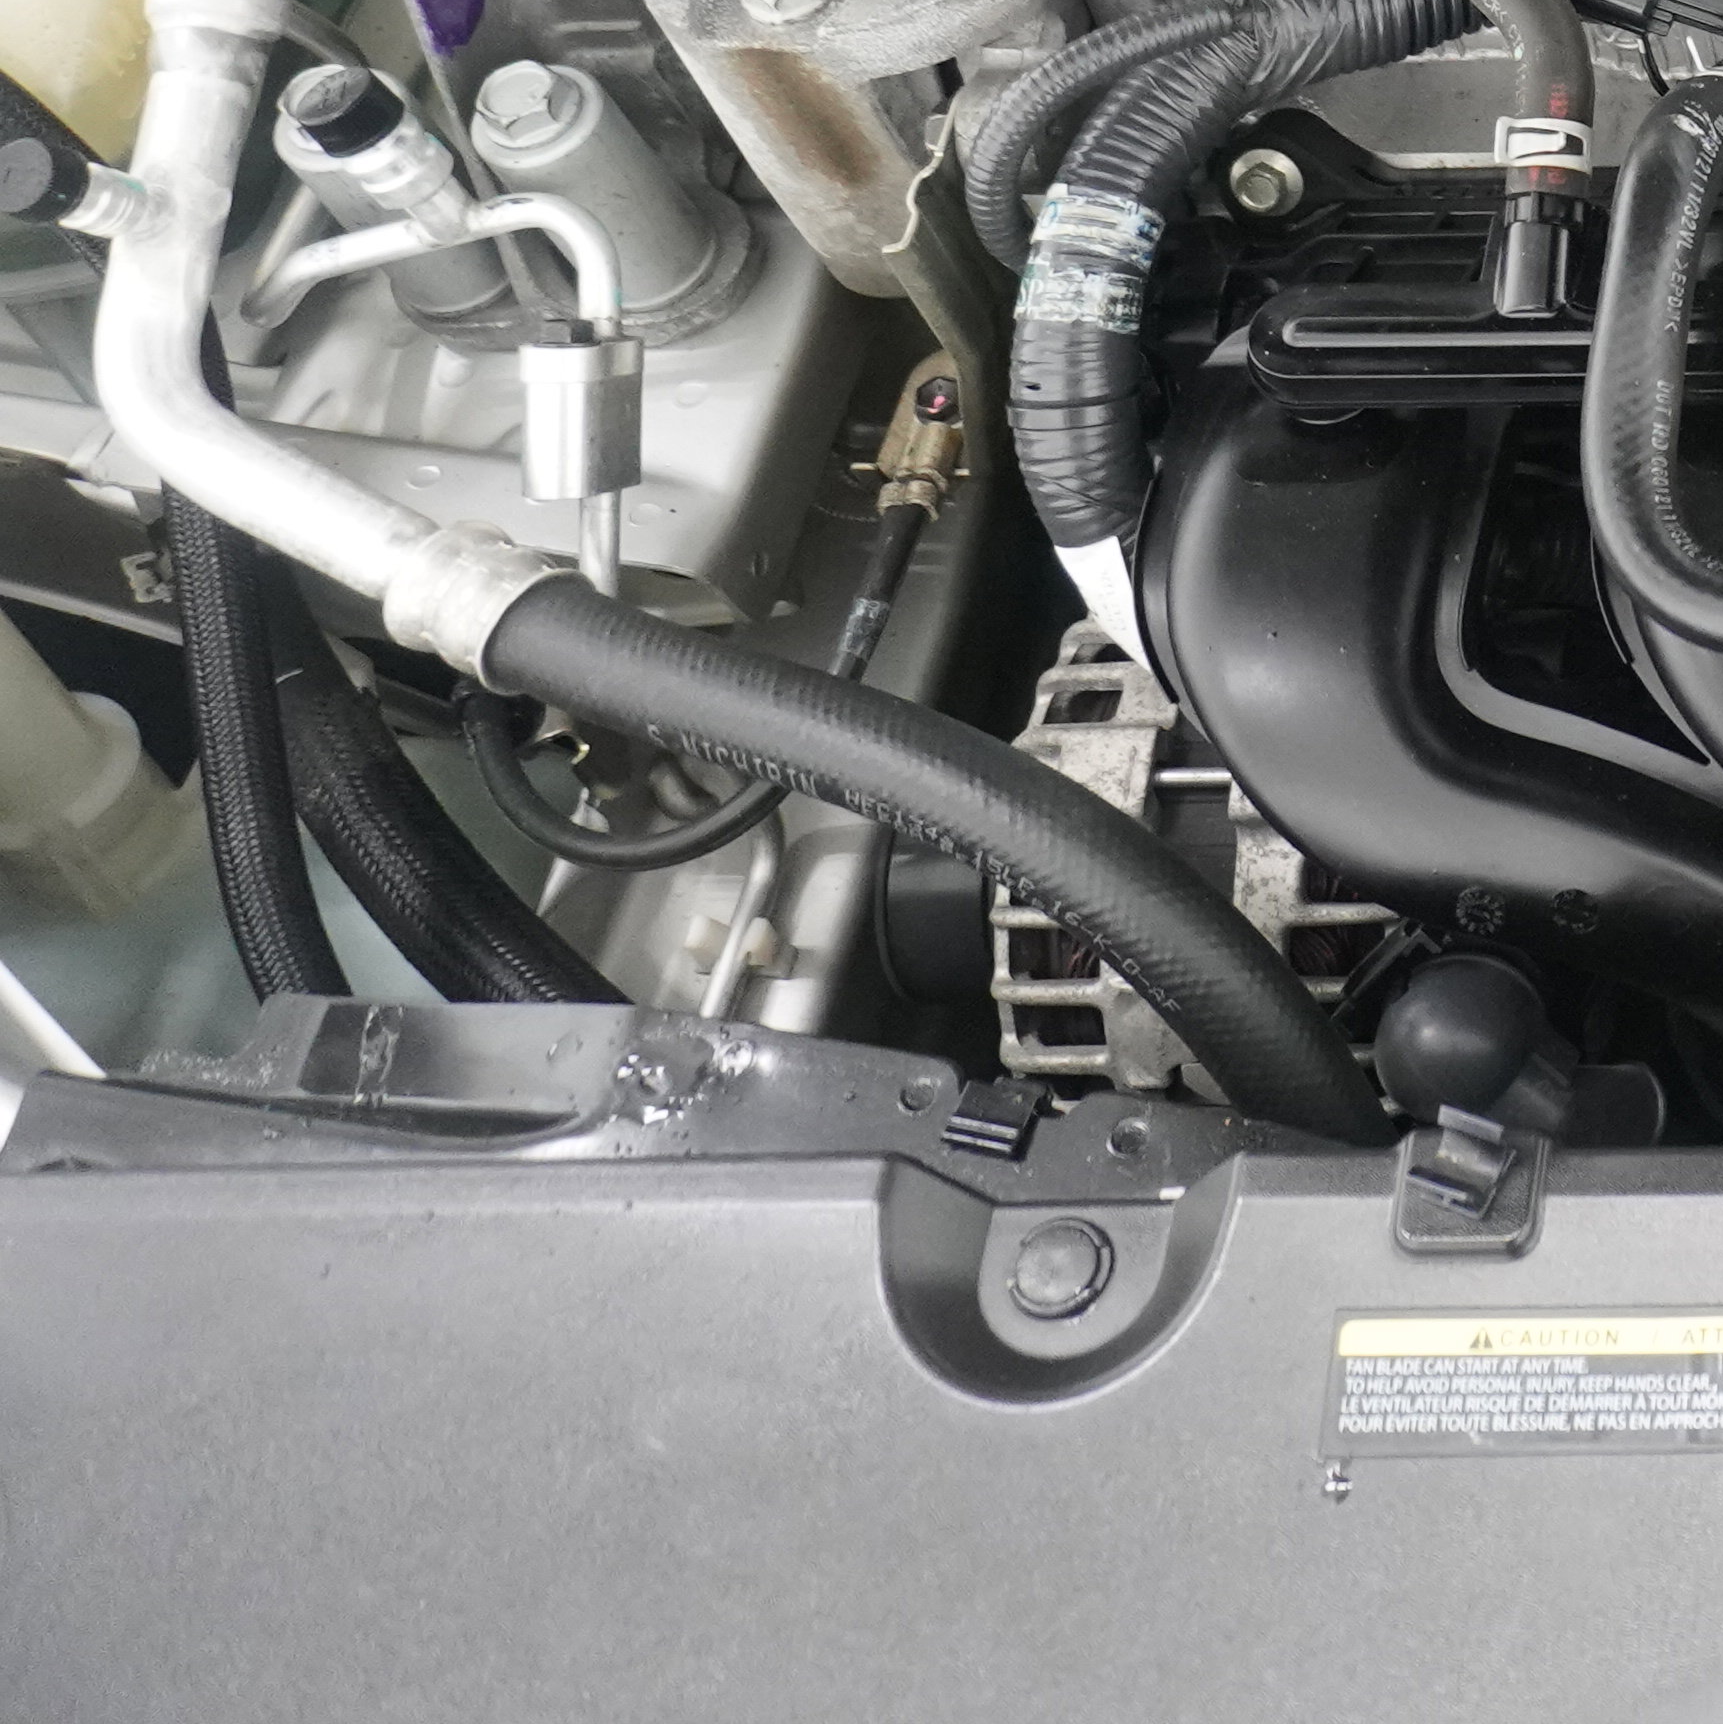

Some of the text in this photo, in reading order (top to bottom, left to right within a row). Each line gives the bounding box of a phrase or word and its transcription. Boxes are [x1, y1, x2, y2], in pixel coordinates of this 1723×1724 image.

[1501, 1329, 1619, 1347] CAUTION
[1346, 1357, 1373, 1375] FAN
[1375, 1357, 1421, 1375] BLADE
[1423, 1357, 1454, 1375] CAN
[1458, 1357, 1500, 1375] START
[1501, 1357, 1522, 1375] AT
[1524, 1357, 1552, 1375] ANY
[1346, 1376, 1364, 1395] TO
[1366, 1376, 1402, 1395] HELP
[1404, 1376, 1449, 1395] AVOID
[1451, 1376, 1522, 1395] PERSONAL
[1578, 1376, 1613, 1395] KEEP
[1617, 1376, 1666, 1395] HANDS
[1341, 1395, 1360, 1414] LE
[1362, 1395, 1463, 1414] VENTILATEUR
[1465, 1395, 1521, 1414] RISQUE
[1523, 1395, 1545, 1414] DE
[1649, 1393, 1690, 1412] TOUT
[1339, 1413, 1384, 1433] POUR
[1439, 1413, 1490, 1433] TOUTE
[1573, 1413, 1596, 1433] NE
[1597, 1411, 1627, 1430] PAS
[1629, 1411, 1653, 1430] EN
